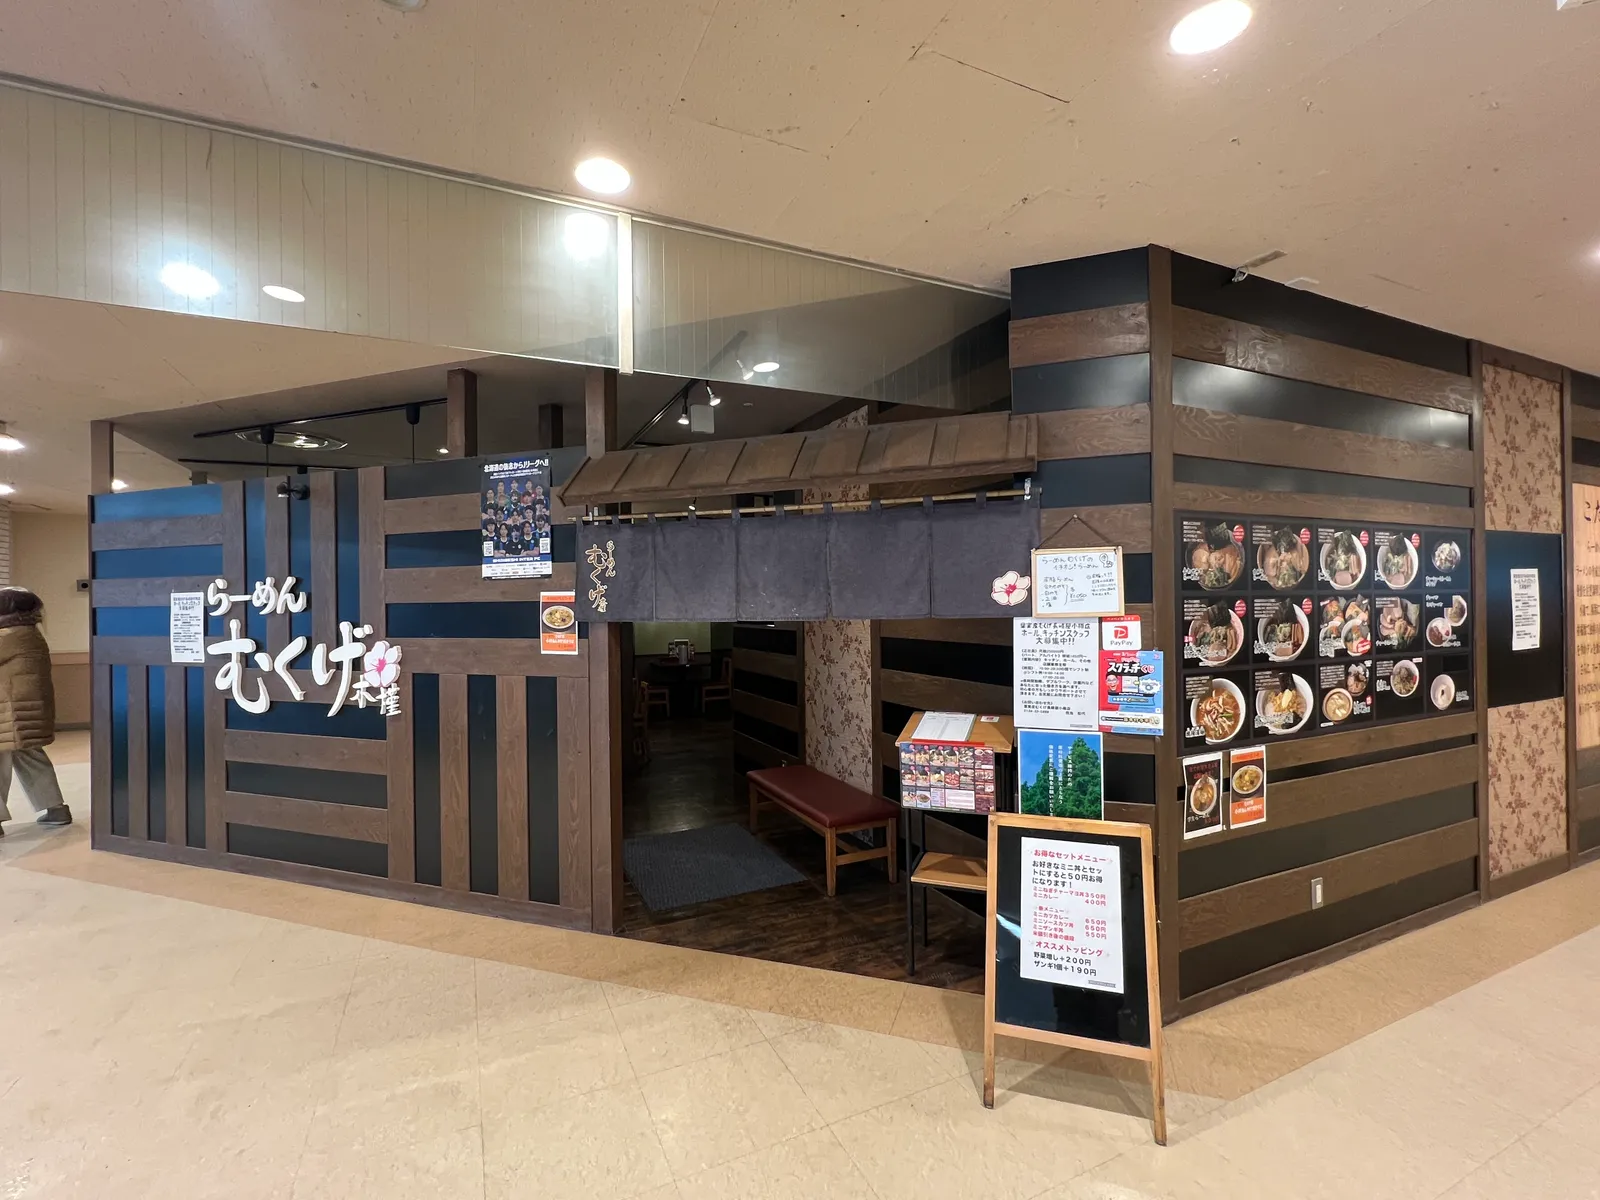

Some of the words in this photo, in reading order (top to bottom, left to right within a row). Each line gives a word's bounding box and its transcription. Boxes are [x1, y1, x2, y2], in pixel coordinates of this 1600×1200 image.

[585, 544, 608, 608] むくげ
[207, 576, 307, 616] らーめん
[207, 618, 374, 718] むくげ
[1107, 662, 1156, 674] スクラッチくじ
[350, 675, 402, 717] 木槿
[1033, 849, 1107, 863] お得なセットメニュー
[1032, 860, 1102, 874] お好きなミニ丼とセッ
[1032, 870, 1103, 883] トにすると50円お得
[1032, 877, 1072, 889] になります!
[1032, 892, 1059, 900] ミニカレー
[1033, 911, 1069, 920] ミニカツカレー
[1085, 918, 1106, 926] 650円
[1033, 918, 1074, 928] ミニソースカツ丼
[1085, 924, 1106, 933] 650円
[1033, 924, 1064, 933] ミニザンギ丼
[1085, 931, 1107, 940] 550円
[1035, 941, 1103, 957] オススメトッピング
[1033, 951, 1092, 966] 野菜増し+200円
